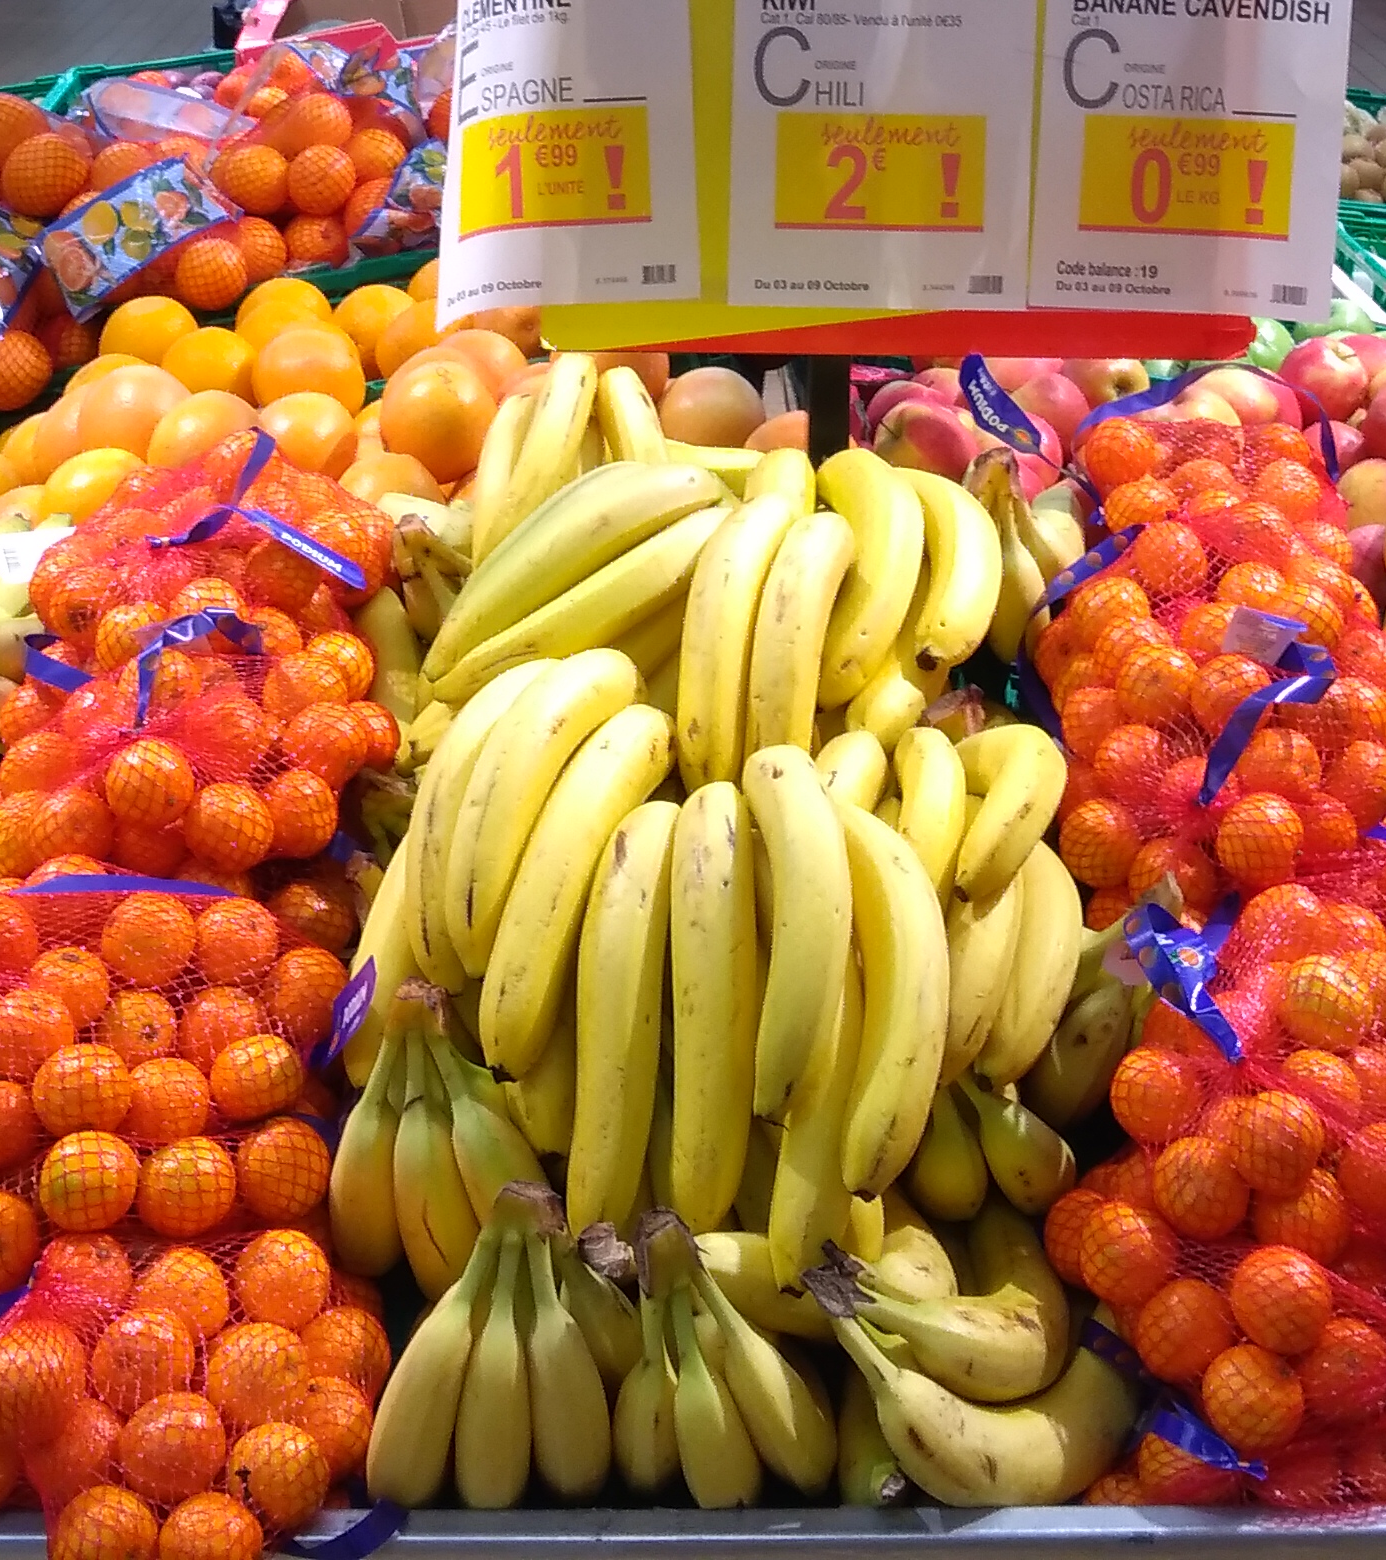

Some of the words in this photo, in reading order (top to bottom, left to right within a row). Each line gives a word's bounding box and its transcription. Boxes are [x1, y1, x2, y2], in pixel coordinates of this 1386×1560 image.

[760, 12, 781, 25] Cat
[854, 14, 889, 27] Vendu
[1071, 13, 1093, 27] Cat
[1180, 85, 1227, 113] RICA
[488, 114, 623, 151] seulement
[821, 116, 961, 146] seulement
[1128, 122, 1269, 153] seulement
[1176, 189, 1194, 204] LE
[1198, 190, 1221, 205] KG
[1056, 260, 1085, 277] Code
[1088, 261, 1131, 278] balance
[497, 279, 543, 291] Octobre
[754, 280, 770, 290] Du
[773, 280, 787, 290] 03
[790, 281, 804, 291] au
[807, 280, 821, 291] 09
[823, 280, 870, 291] Octobre
[1056, 280, 1072, 291] Du
[1075, 281, 1089, 292] 03
[1092, 283, 1106, 293] au
[1108, 282, 1122, 293] 09
[1125, 283, 1171, 295] Octobre
[967, 379, 1011, 433] PODIUM
[281, 531, 343, 573] PODIUM
